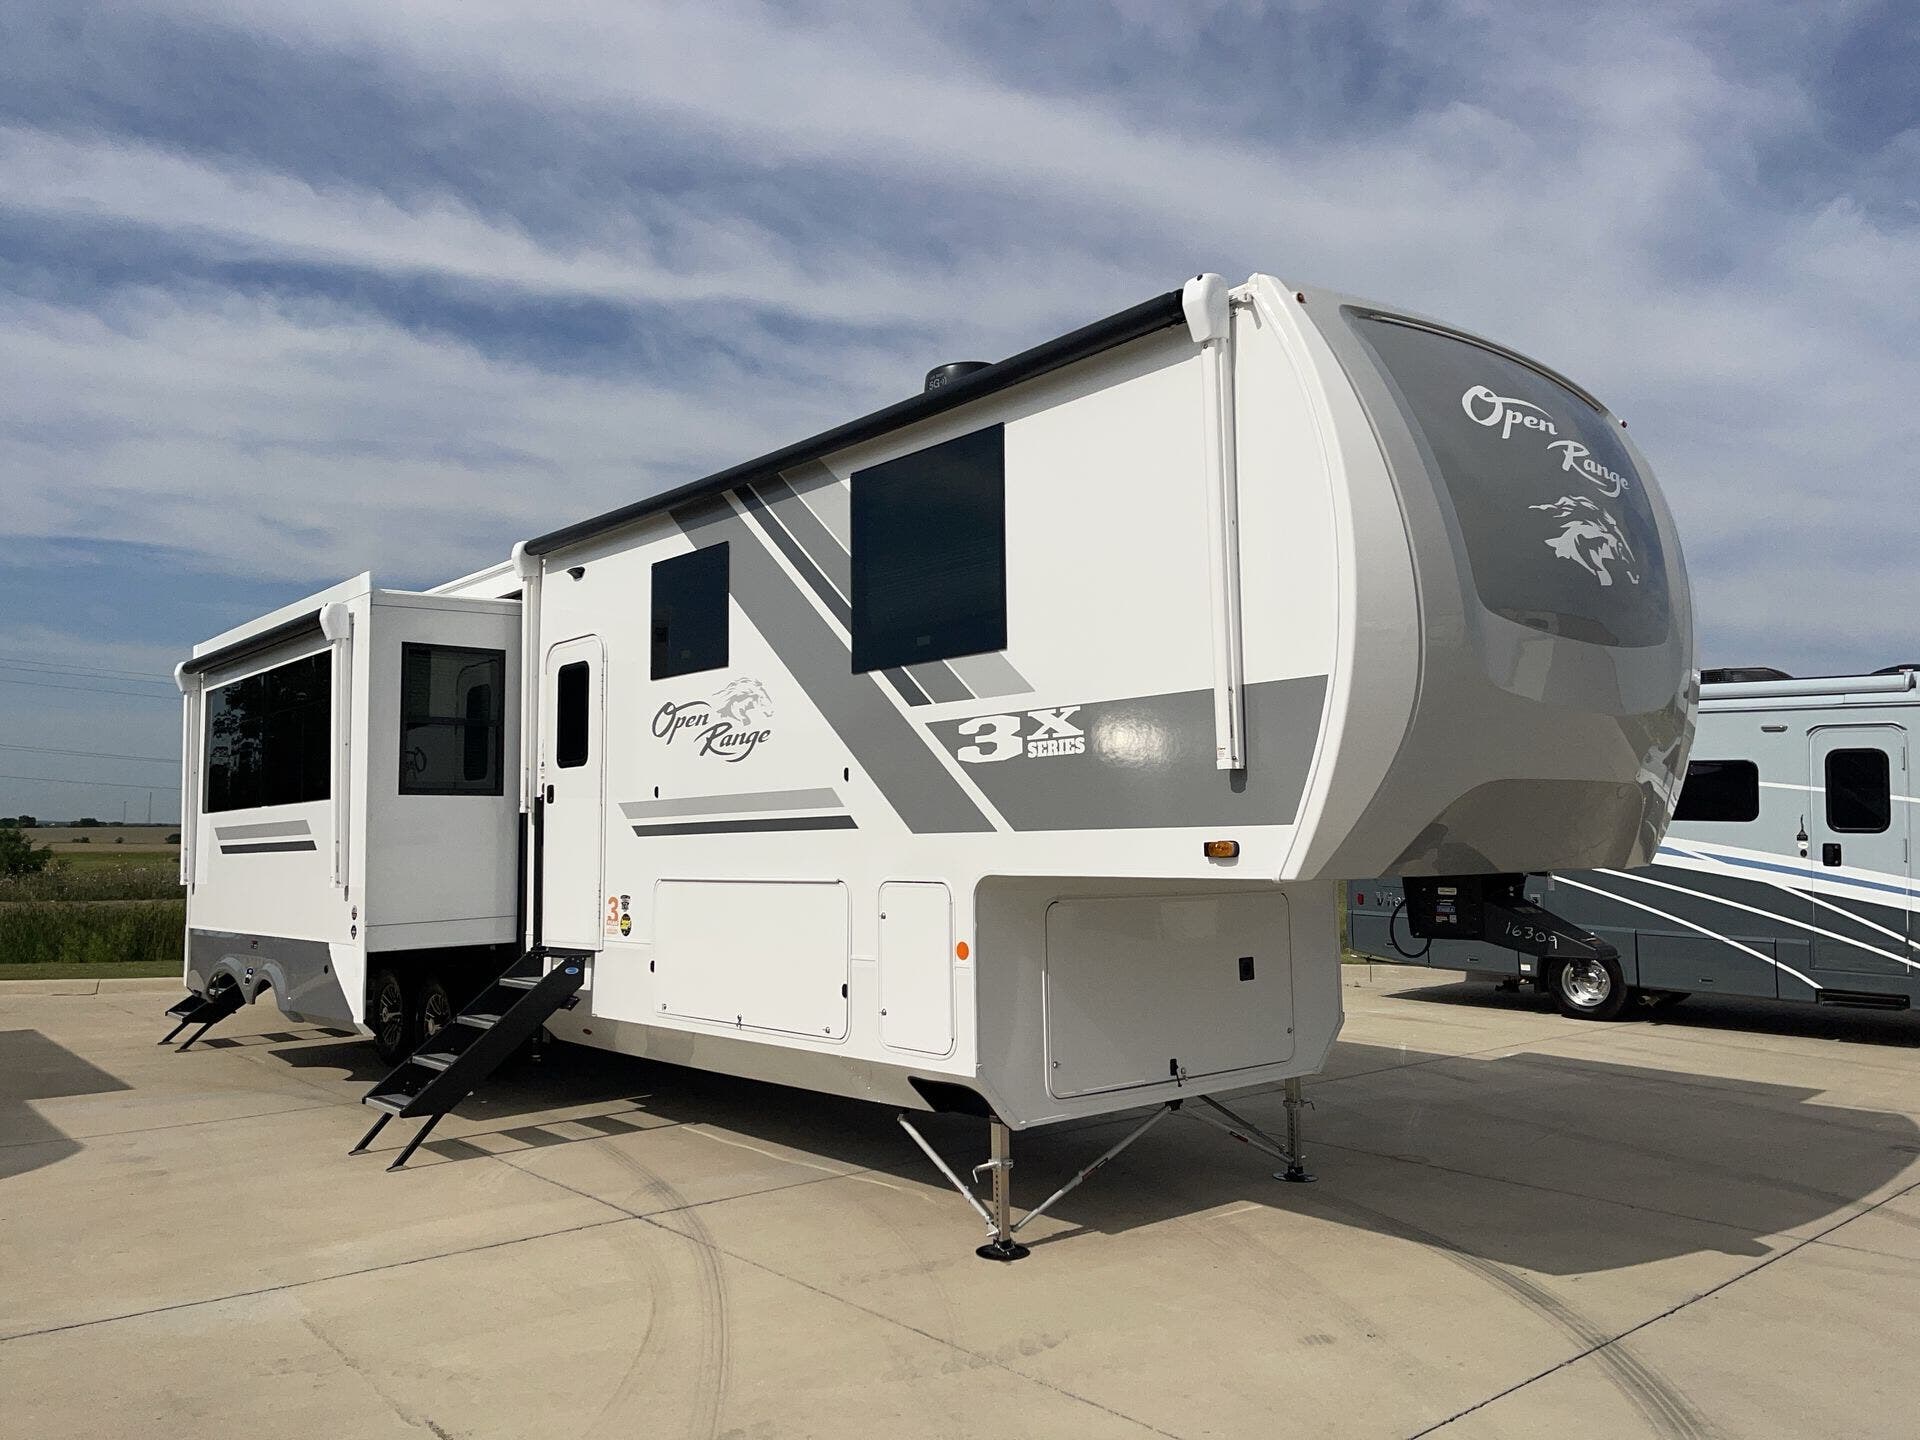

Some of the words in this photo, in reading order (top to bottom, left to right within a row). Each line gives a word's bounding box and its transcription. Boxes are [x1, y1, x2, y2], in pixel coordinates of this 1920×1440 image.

[1461, 385, 1558, 439] Open
[1546, 439, 1630, 498] Range
[652, 700, 712, 745] Open
[693, 721, 771, 763] Range
[1027, 737, 1086, 759] SERIES
[1505, 921, 1558, 950] 16309
